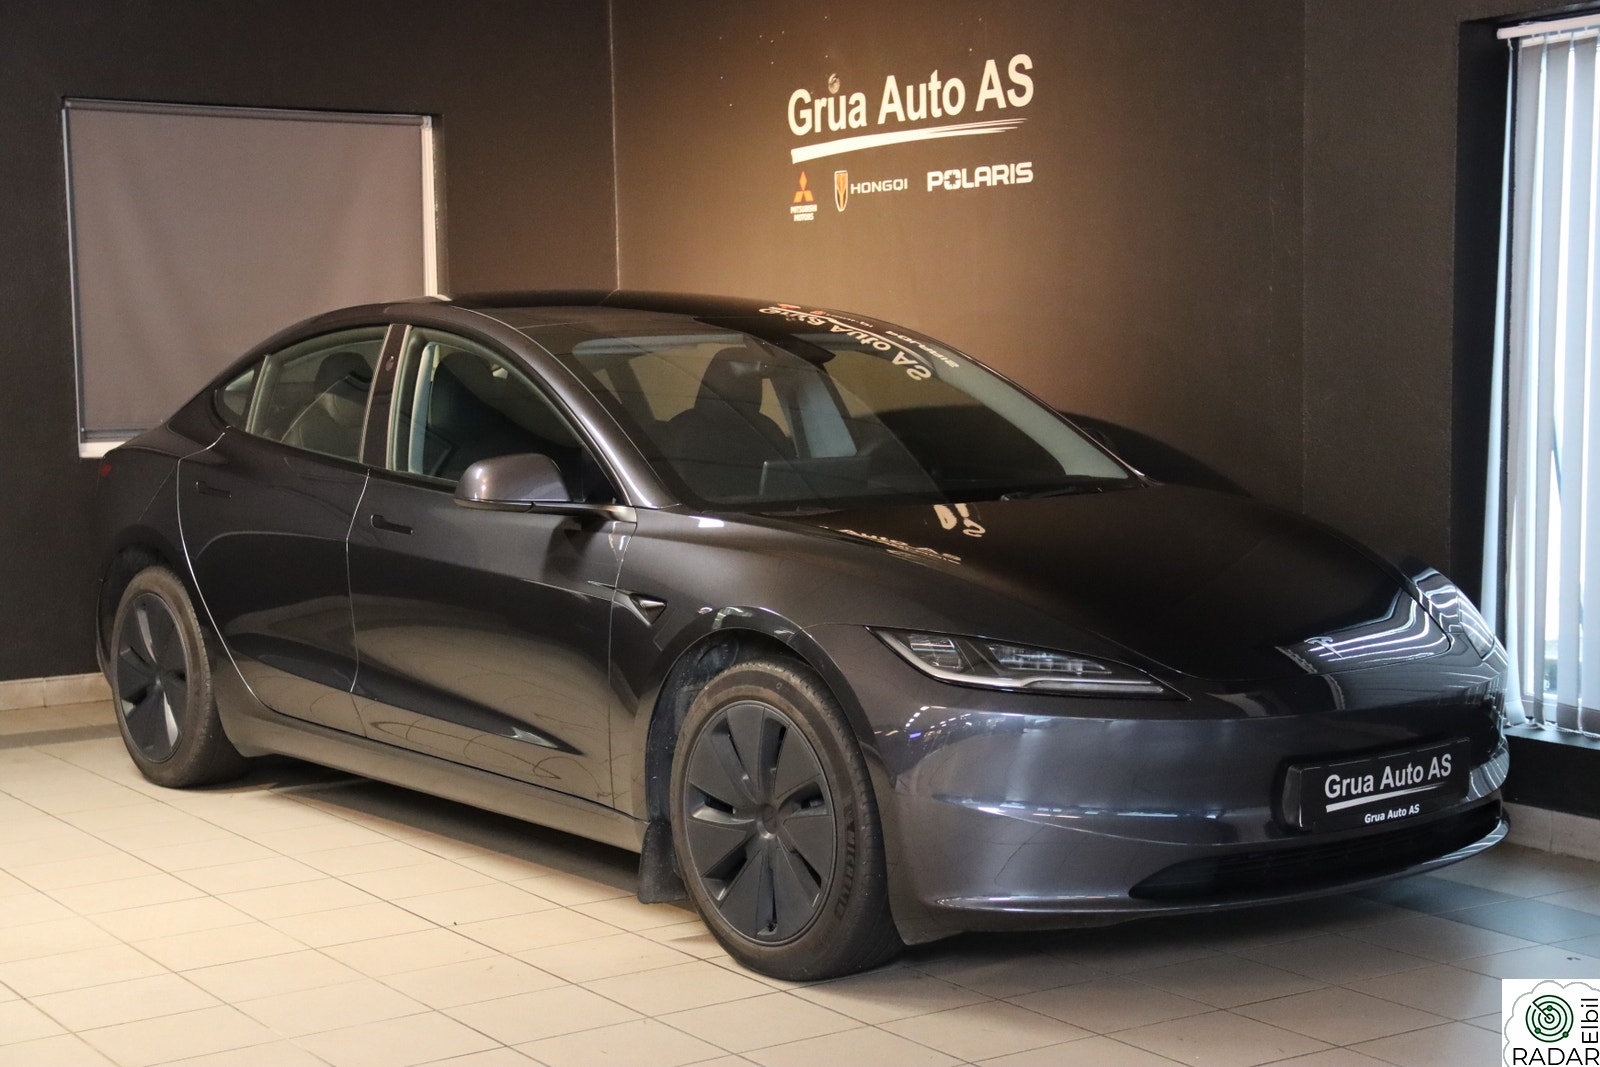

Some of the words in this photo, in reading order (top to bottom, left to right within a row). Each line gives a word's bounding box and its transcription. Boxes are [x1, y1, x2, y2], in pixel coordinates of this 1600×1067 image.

[877, 69, 966, 125] Auto
[975, 53, 1034, 112] AS
[850, 178, 908, 194] HONGQI
[927, 161, 1034, 192] POLARIS
[1325, 774, 1374, 798] Grua
[1380, 762, 1424, 790] Auto
[1427, 753, 1452, 779] AS
[1364, 812, 1385, 823] Grua
[1387, 808, 1407, 819] Auto
[1408, 804, 1420, 814] AS
